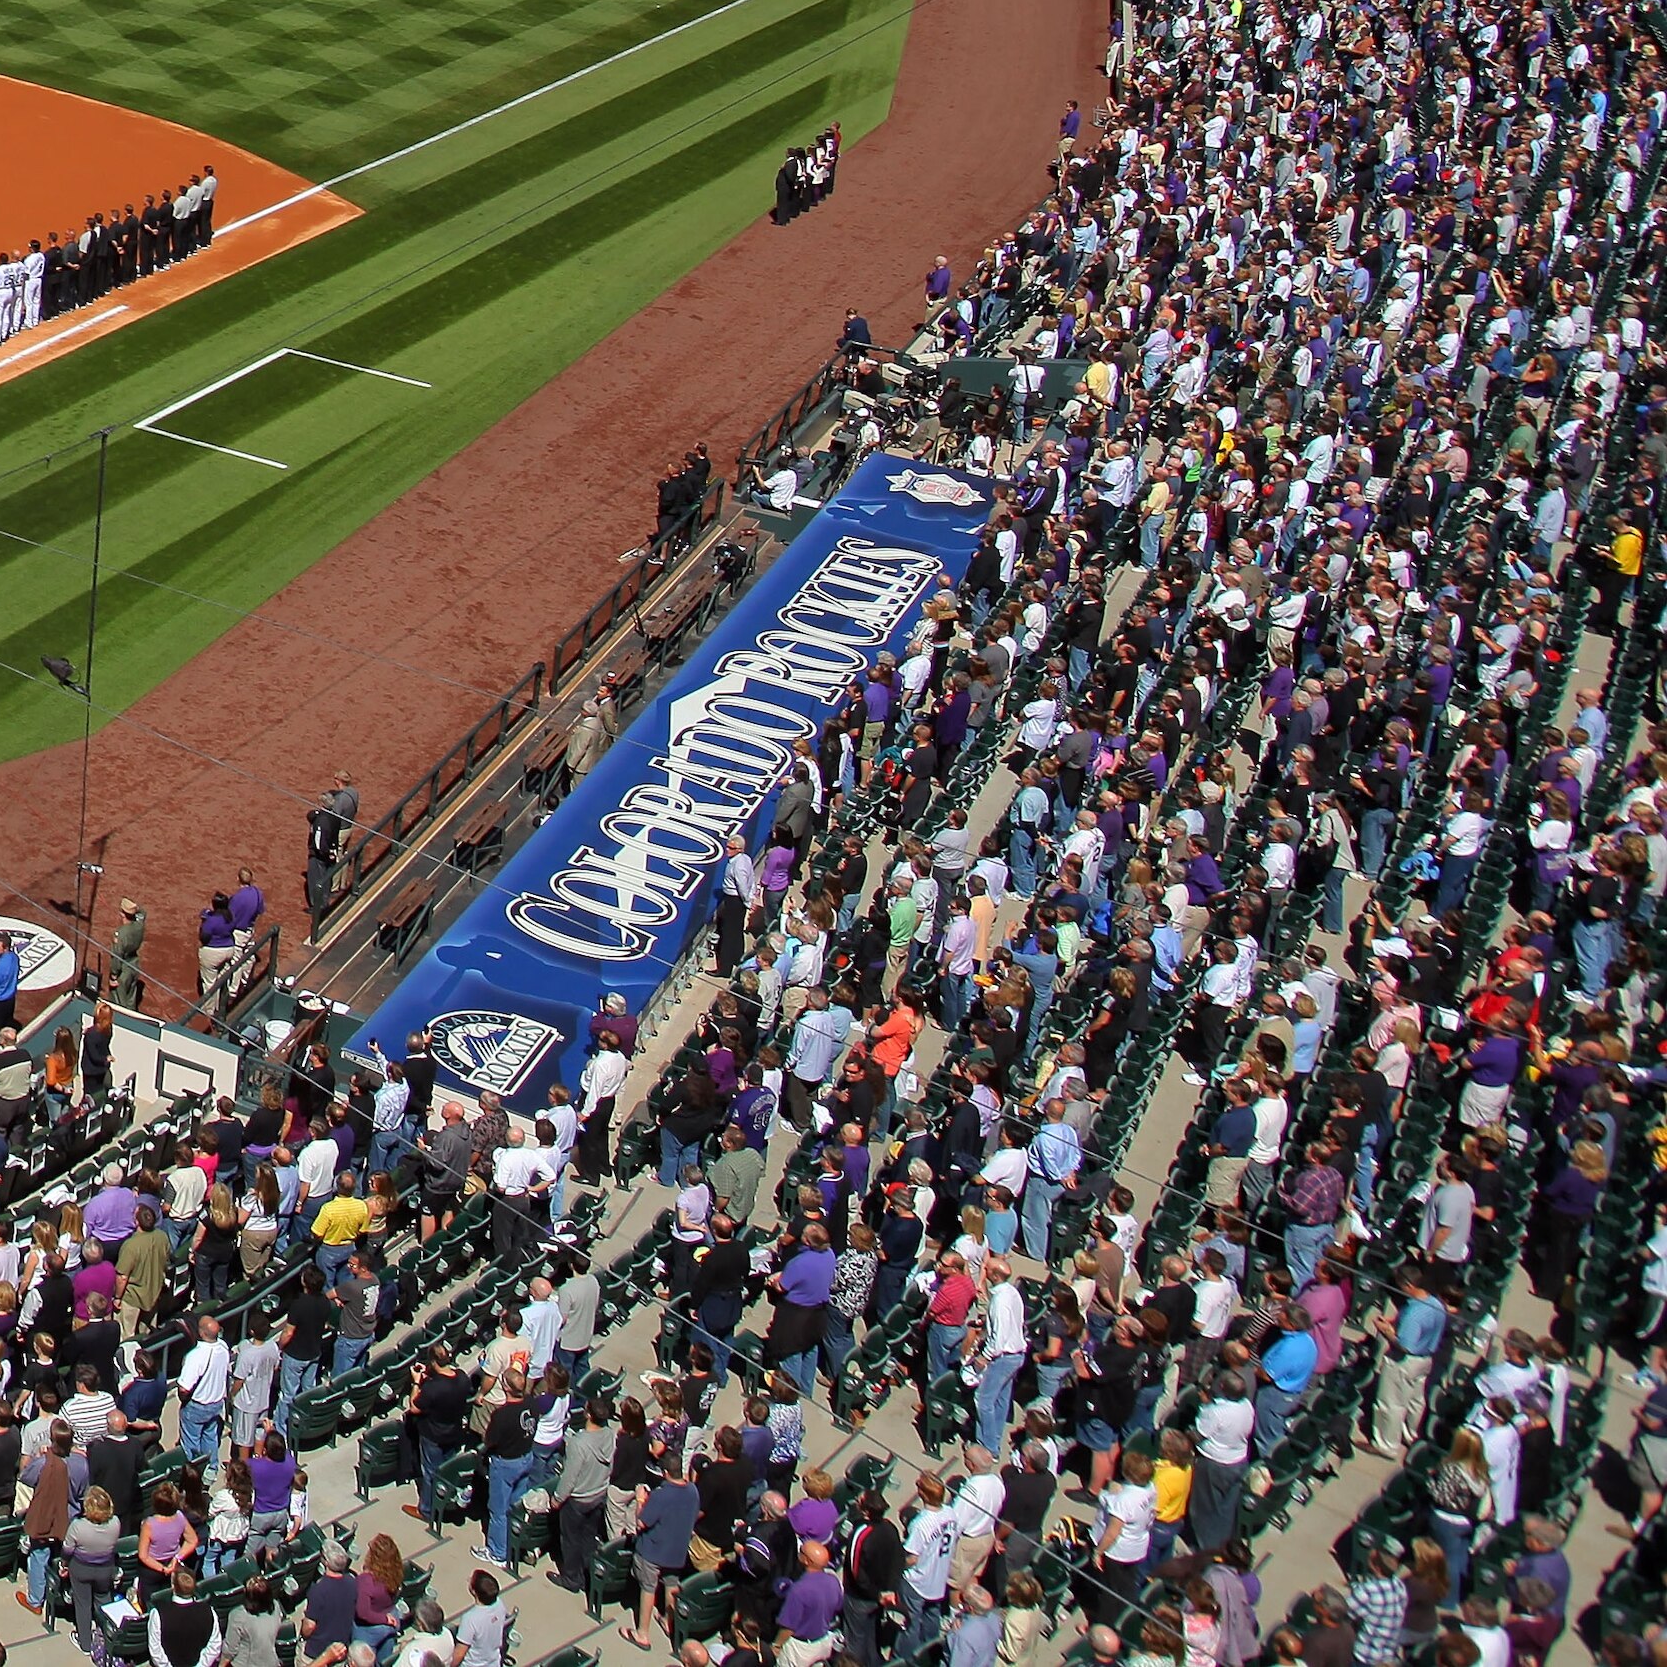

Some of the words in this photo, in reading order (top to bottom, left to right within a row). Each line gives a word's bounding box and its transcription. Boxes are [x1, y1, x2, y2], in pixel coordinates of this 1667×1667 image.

[505, 694, 820, 962] COLORADO
[713, 535, 944, 707] ROCKIES
[432, 1014, 503, 1070] COLORADO
[474, 1021, 546, 1087] ROCKIES
